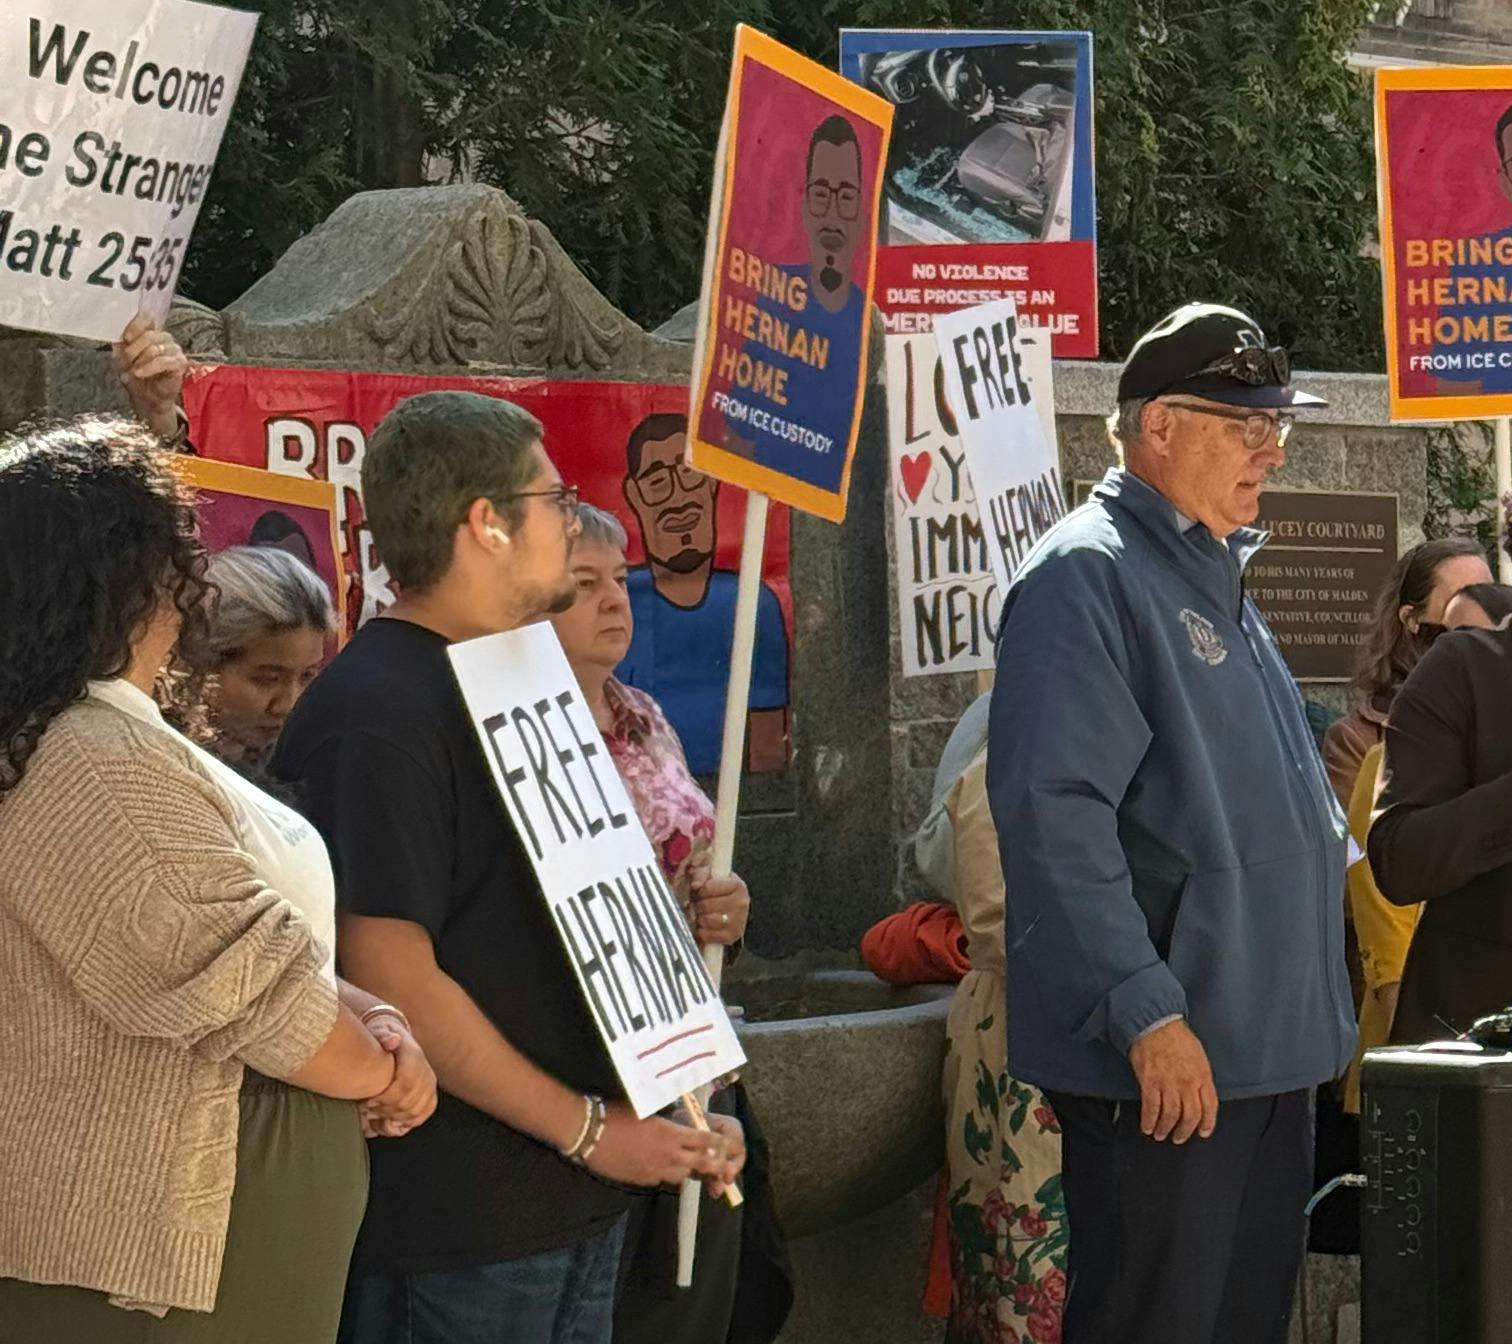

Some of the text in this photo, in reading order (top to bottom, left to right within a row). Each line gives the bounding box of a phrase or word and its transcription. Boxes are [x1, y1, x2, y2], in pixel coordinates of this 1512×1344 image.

[27, 17, 225, 117] Welcome
[728, 247, 809, 312] BRING
[886, 288, 922, 305] DUE
[1030, 290, 1056, 306] AN
[911, 263, 1030, 282] NO VIOLENCE
[724, 294, 830, 371] HERNAN
[1018, 313, 1080, 334] ALUE
[717, 343, 789, 406] HOME
[952, 315, 1031, 421] FREE
[1409, 353, 1462, 372] FROM
[1466, 351, 1496, 369] ICE
[711, 391, 835, 455] FROM ICE CUSTODY
[1307, 520, 1386, 541] COURTYARD
[1284, 566, 1311, 579] MANY
[482, 690, 628, 861] FREE
[555, 864, 718, 1044] HERNAN
